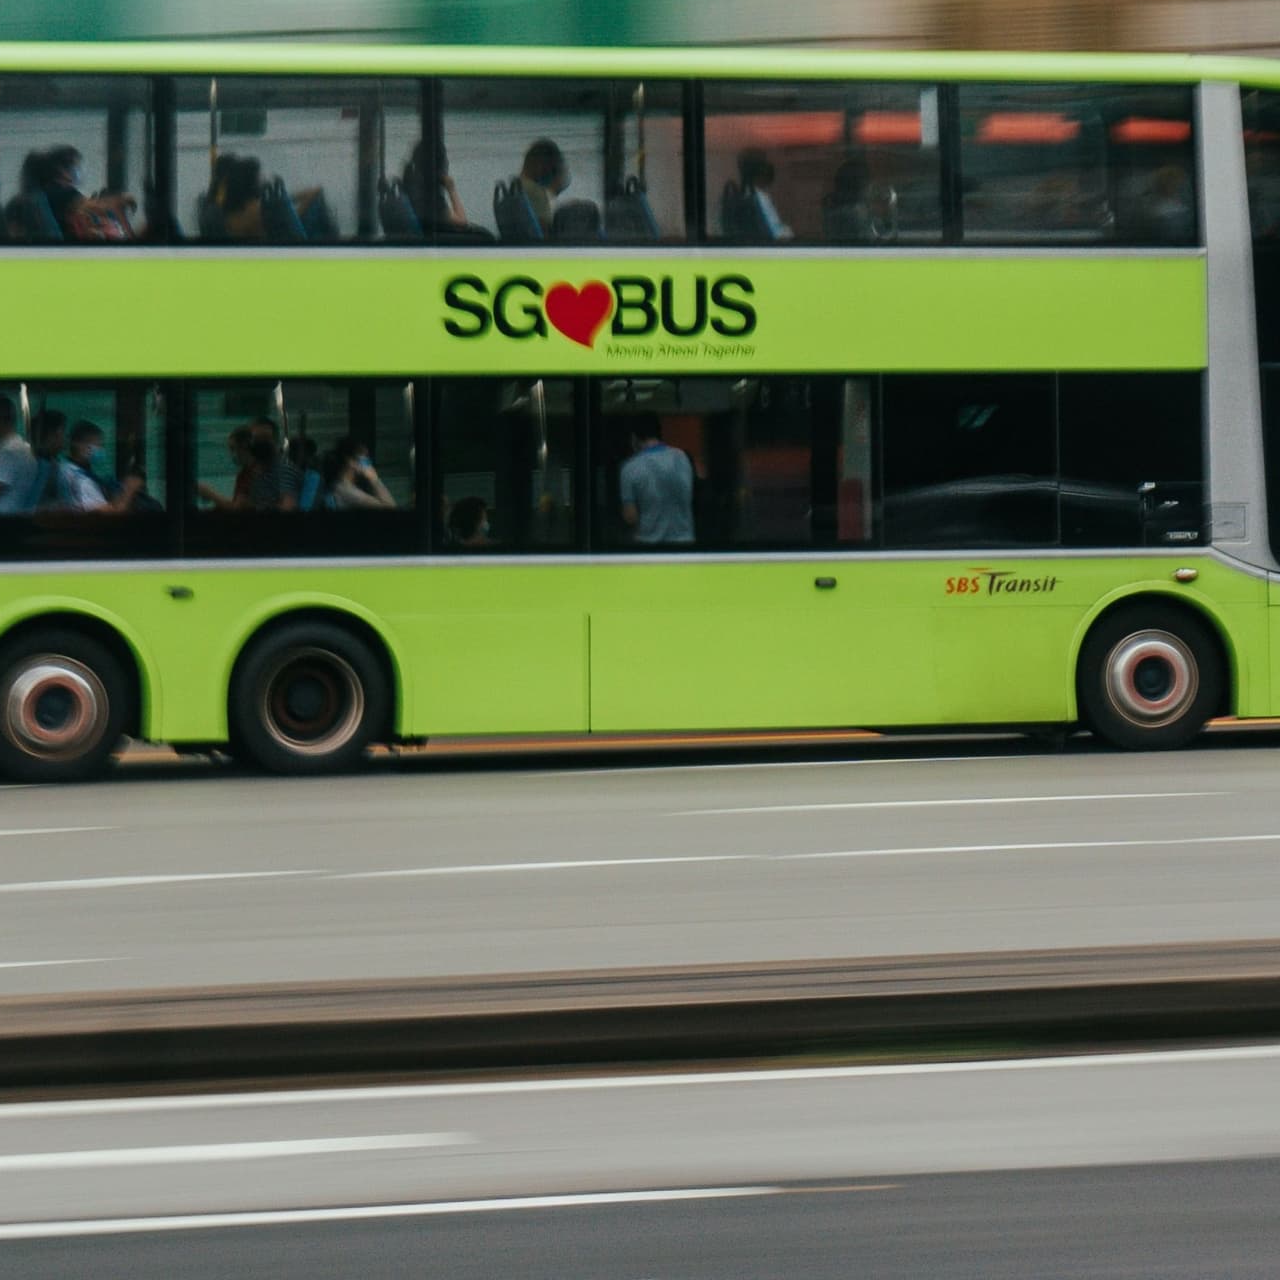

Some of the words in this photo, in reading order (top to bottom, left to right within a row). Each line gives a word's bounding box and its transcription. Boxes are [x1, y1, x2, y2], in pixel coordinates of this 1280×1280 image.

[606, 344, 653, 360] Moving
[657, 343, 699, 358] Ahead
[702, 341, 756, 360] Together
[945, 576, 980, 594] SBS
[982, 571, 1062, 595] Transit
